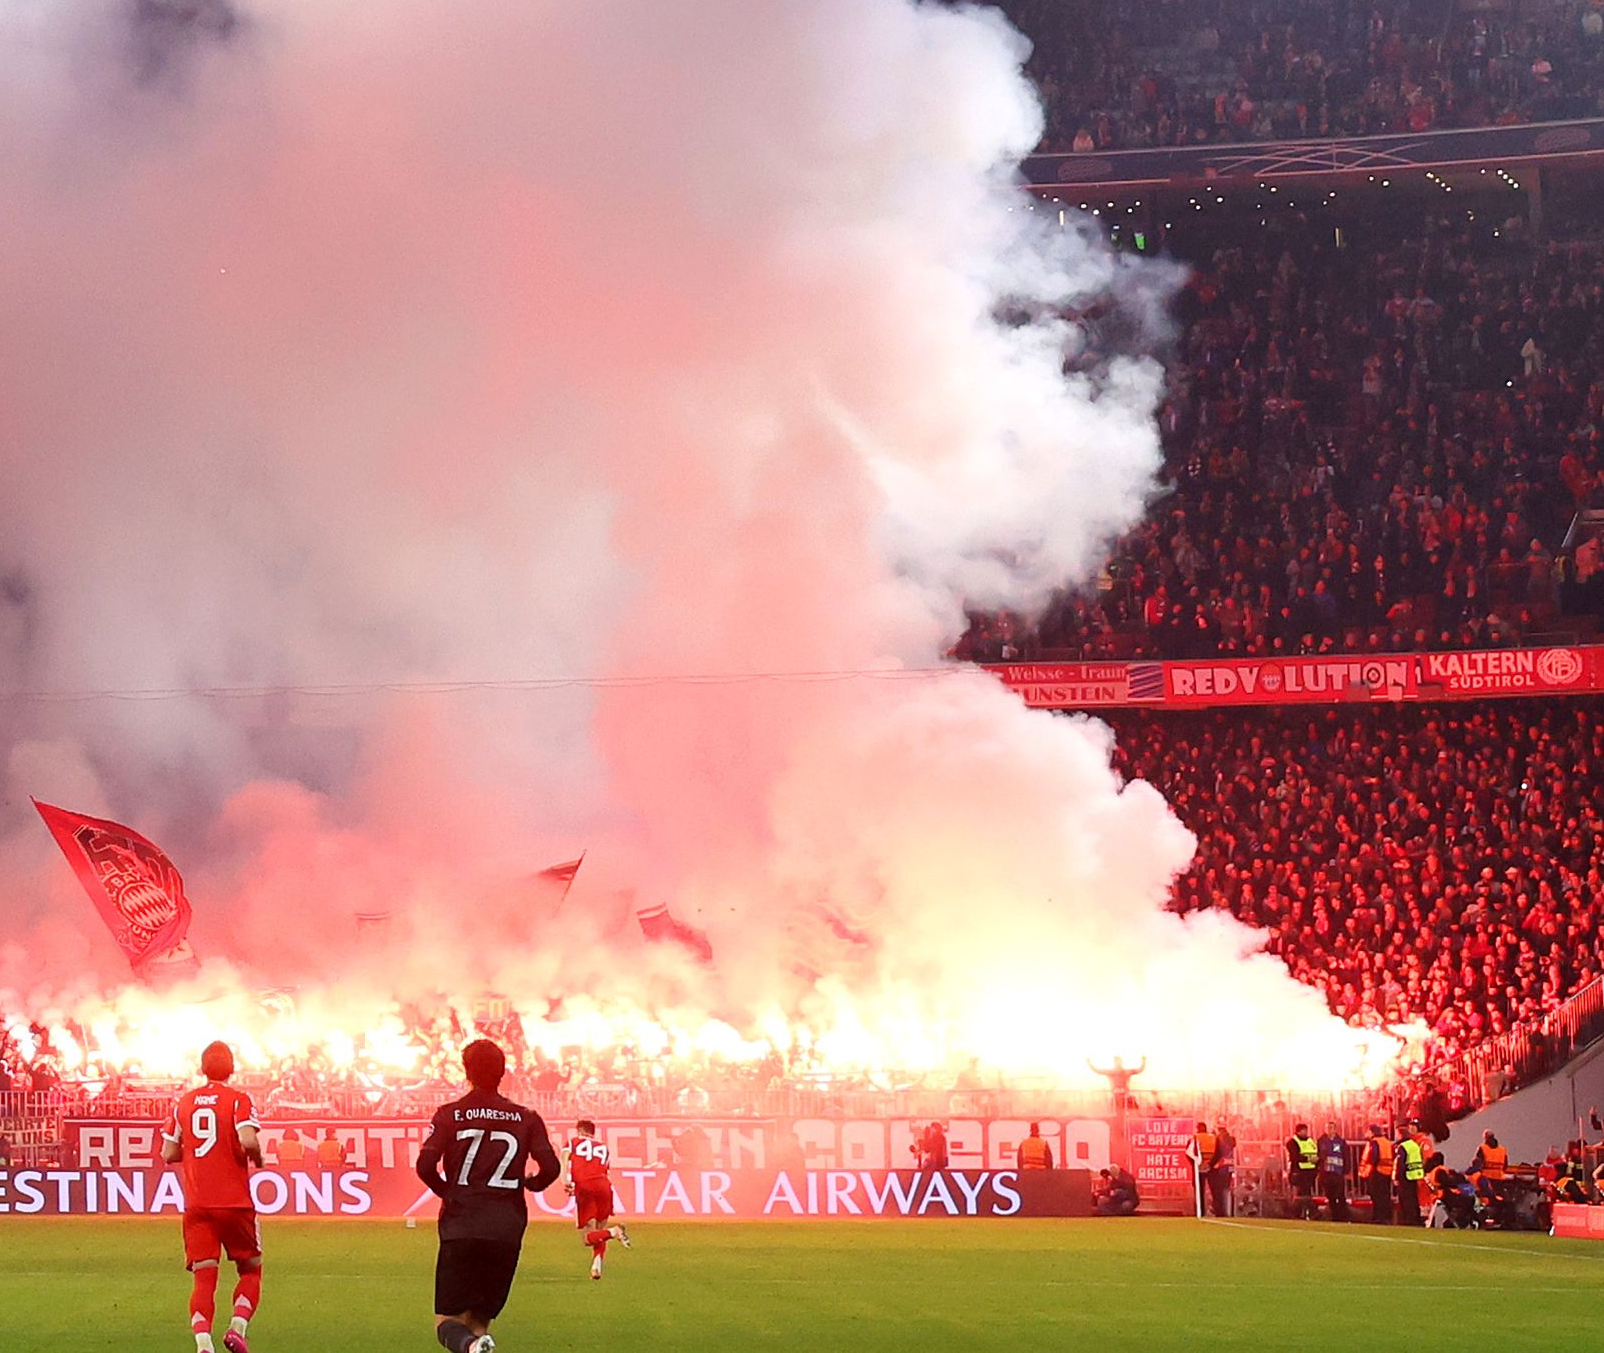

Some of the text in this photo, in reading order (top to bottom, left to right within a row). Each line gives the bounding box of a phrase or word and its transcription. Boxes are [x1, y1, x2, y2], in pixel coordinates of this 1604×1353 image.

[1429, 651, 1534, 676] KALTERN
[1009, 666, 1064, 681] Weisse
[454, 1107, 521, 1122] E. QUARESMA
[191, 1108, 217, 1158] 9
[1145, 1121, 1178, 1133] LOVE
[1132, 1134, 1146, 1146] FC
[456, 1128, 520, 1189] 72
[575, 1139, 608, 1165] 44
[1146, 1154, 1180, 1166] HATE
[1138, 1166, 1188, 1180] RACISM
[762, 1170, 1023, 1216] AIRWAYS
